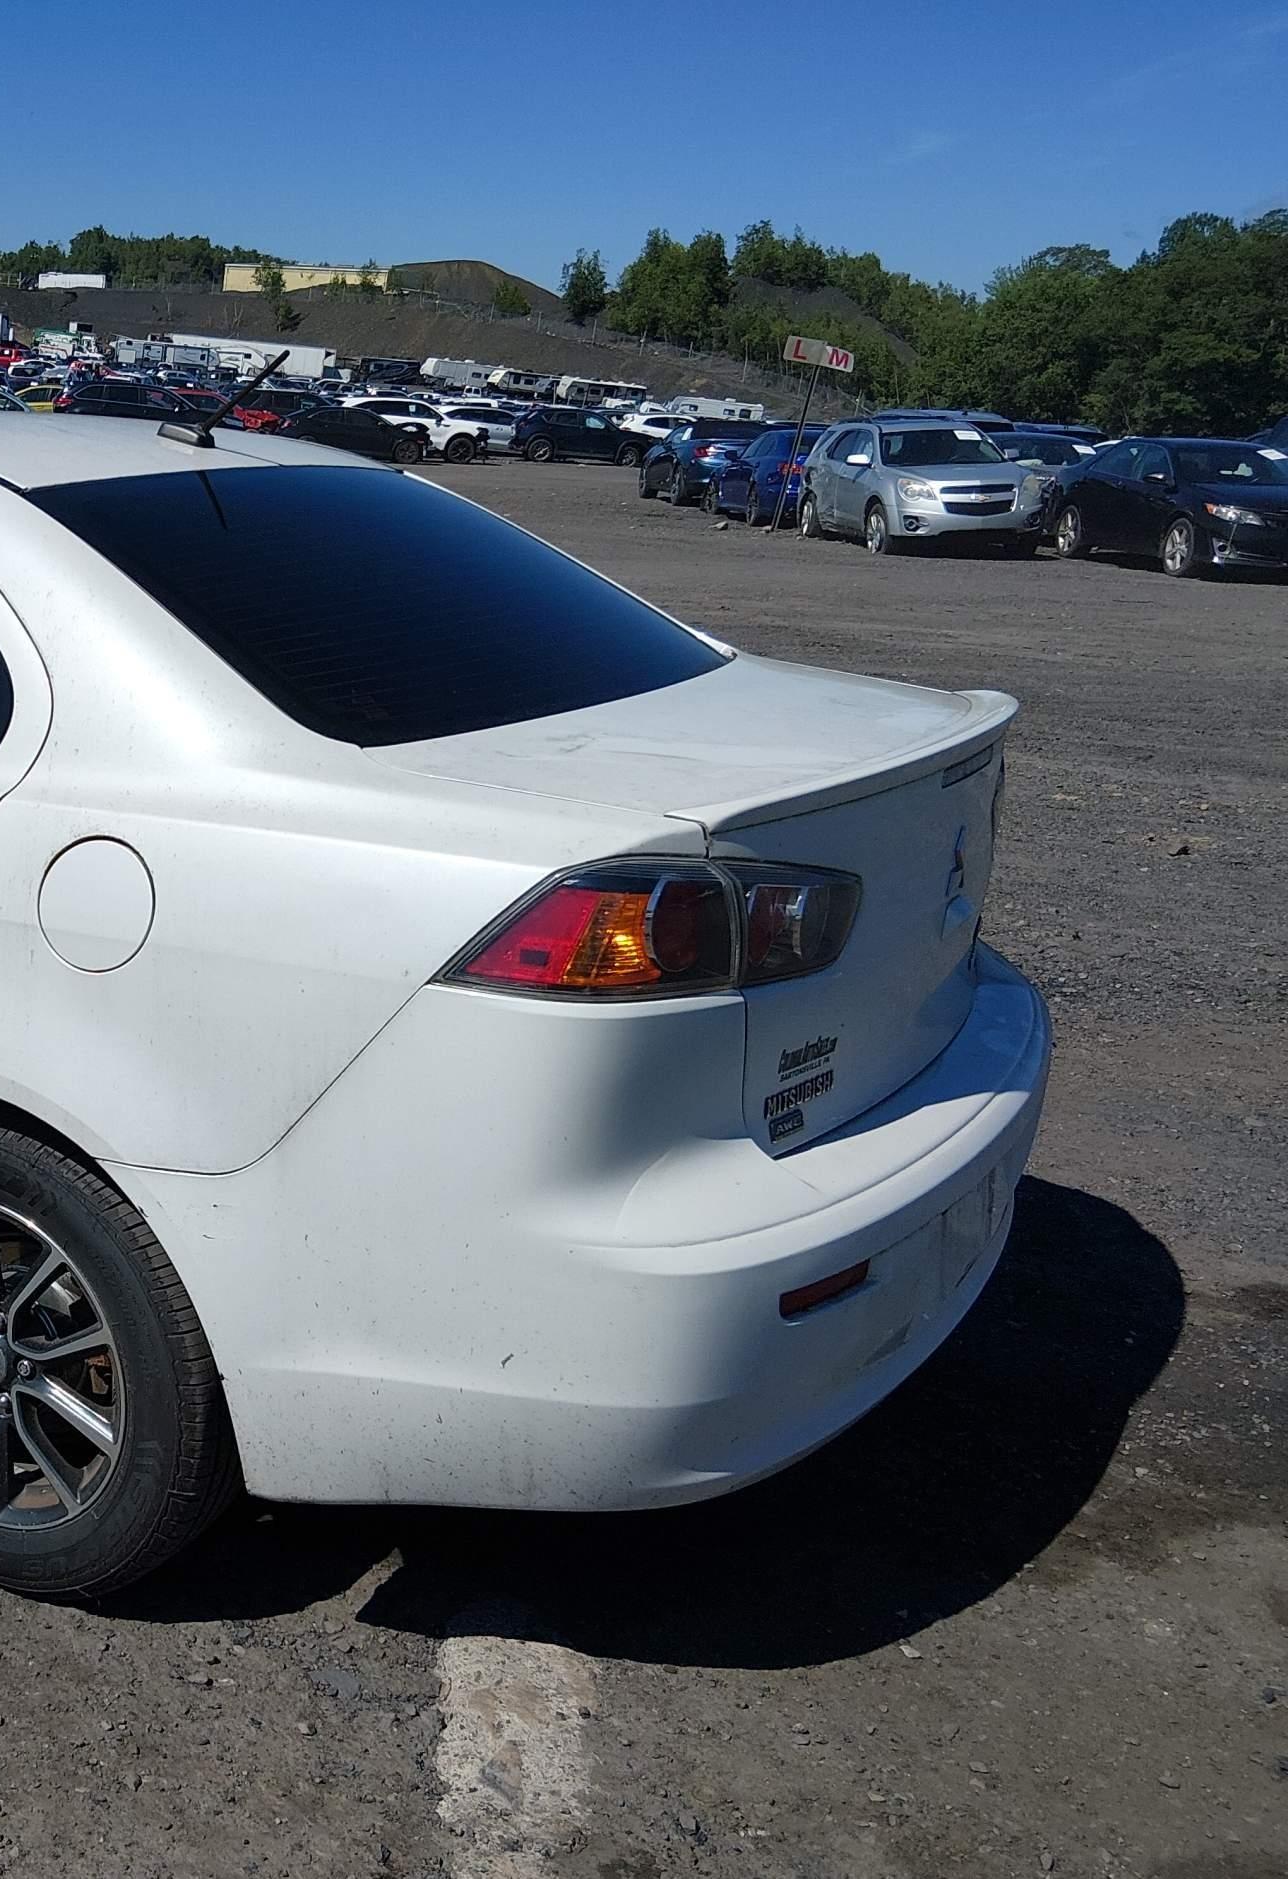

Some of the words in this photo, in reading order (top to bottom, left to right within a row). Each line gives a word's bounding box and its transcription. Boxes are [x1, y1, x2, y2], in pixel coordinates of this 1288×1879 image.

[792, 339, 808, 360] L
[828, 348, 849, 369] M
[763, 1070, 835, 1120] MITSUBISHI
